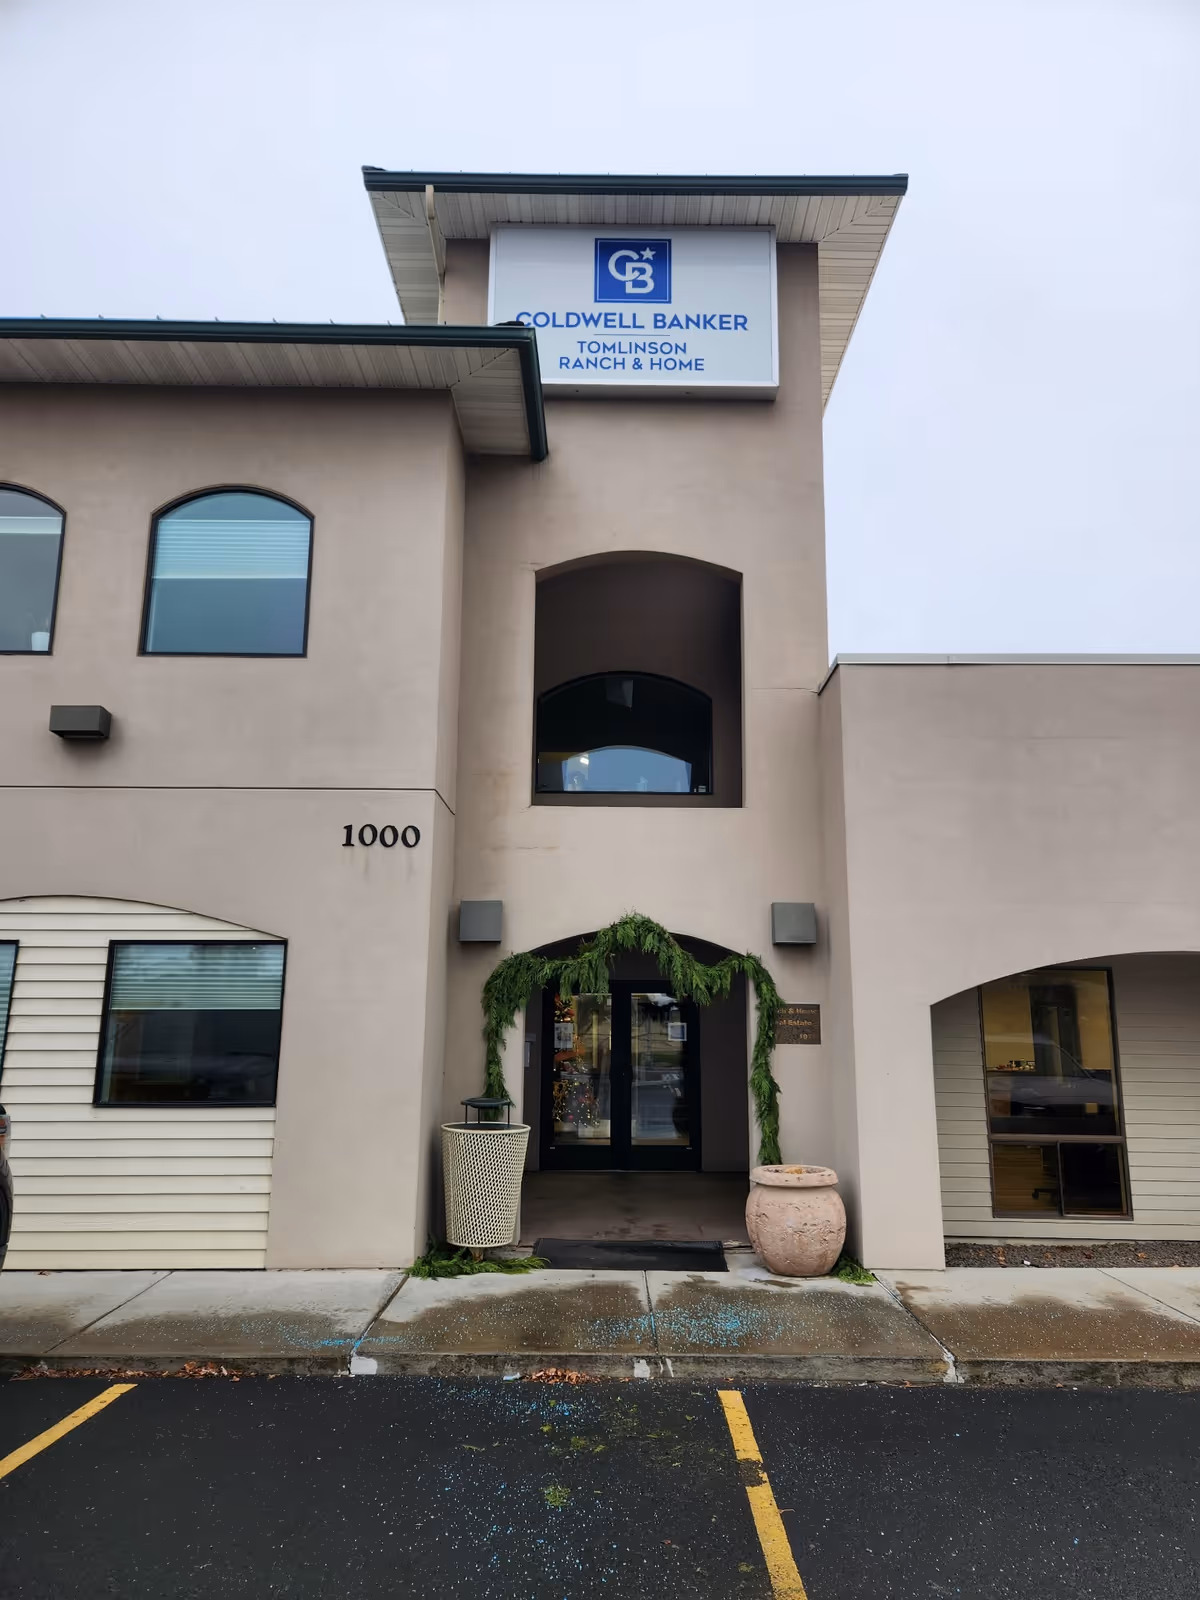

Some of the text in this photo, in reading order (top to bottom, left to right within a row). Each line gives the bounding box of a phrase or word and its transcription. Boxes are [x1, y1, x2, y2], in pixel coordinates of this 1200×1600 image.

[515, 311, 748, 331] COLDWELL BANKER
[577, 340, 687, 355] TOMLINSON
[559, 356, 705, 371] RANCH & HOME
[341, 823, 421, 848] 1000
